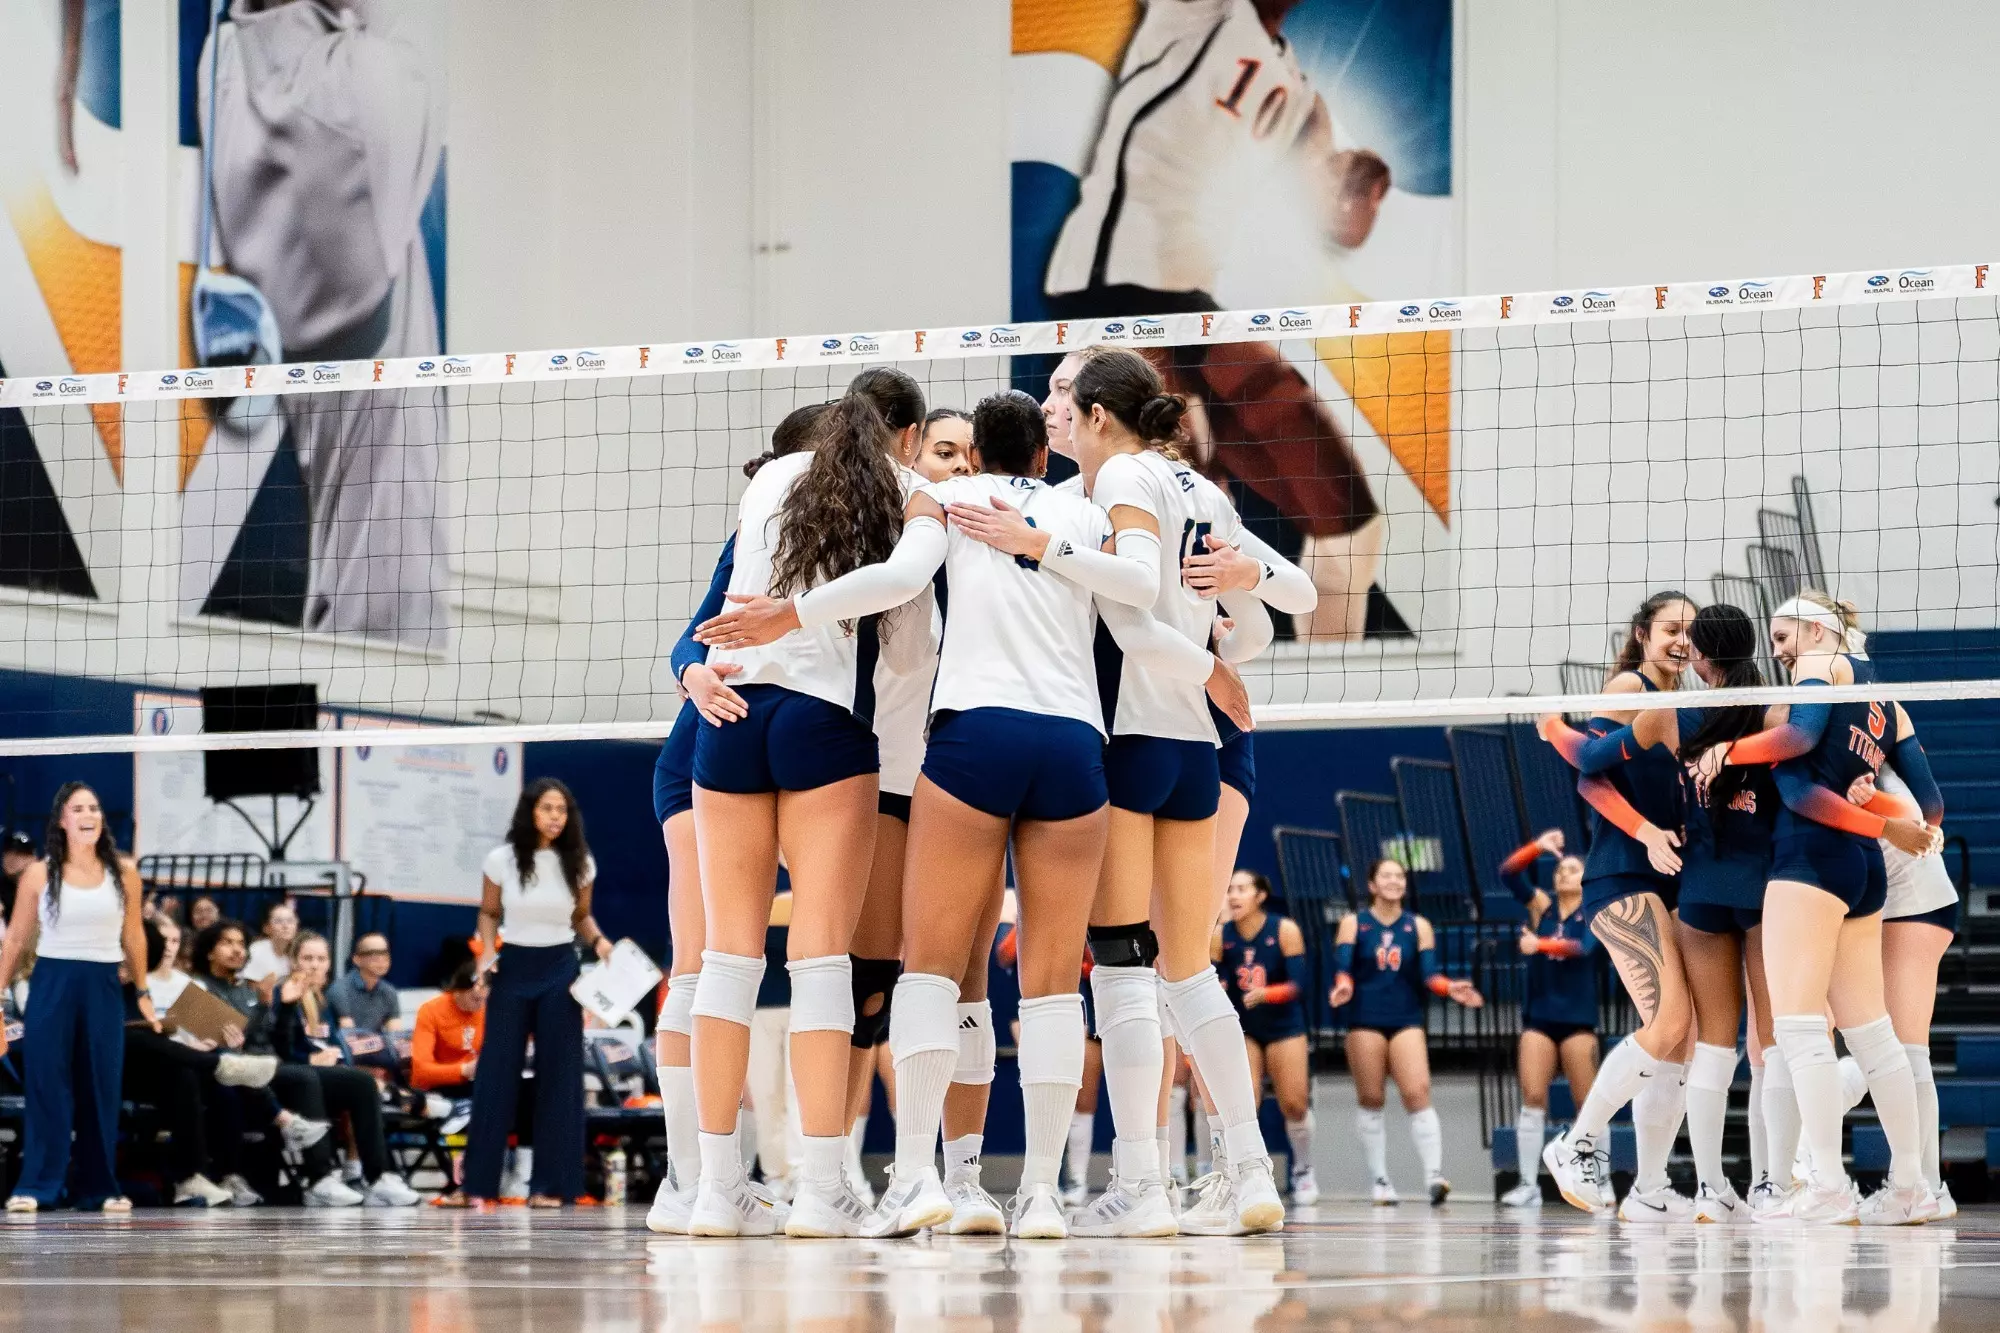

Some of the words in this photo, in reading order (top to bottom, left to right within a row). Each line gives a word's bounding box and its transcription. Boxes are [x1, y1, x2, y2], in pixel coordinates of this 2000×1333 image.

[1215, 57, 1288, 141] 10
[1899, 277, 1933, 289] Ocean
[1975, 265, 1989, 288] F
[1739, 288, 1772, 299] Ocean
[1813, 276, 1826, 299] F
[1501, 296, 1513, 319] F
[1582, 298, 1615, 309] Ocean
[1655, 287, 1668, 309] F
[1279, 316, 1311, 327] Ocean
[1349, 306, 1361, 328] F
[1429, 307, 1461, 318] Ocean
[1057, 323, 1068, 344] F
[1133, 324, 1164, 335] Ocean
[1201, 315, 1213, 336] F
[850, 341, 878, 351] Ocean
[915, 331, 926, 352] F
[990, 333, 1020, 343] Ocean
[639, 347, 650, 368] F
[712, 349, 741, 359] Ocean
[776, 339, 787, 360] F
[373, 361, 385, 382] F
[443, 363, 471, 373] Ocean
[506, 354, 516, 375] F
[577, 356, 605, 367] Ocean
[118, 374, 128, 394] F
[185, 376, 213, 386] Ocean
[245, 368, 255, 388] F
[313, 369, 340, 380] Ocean
[59, 383, 86, 393] Ocean
